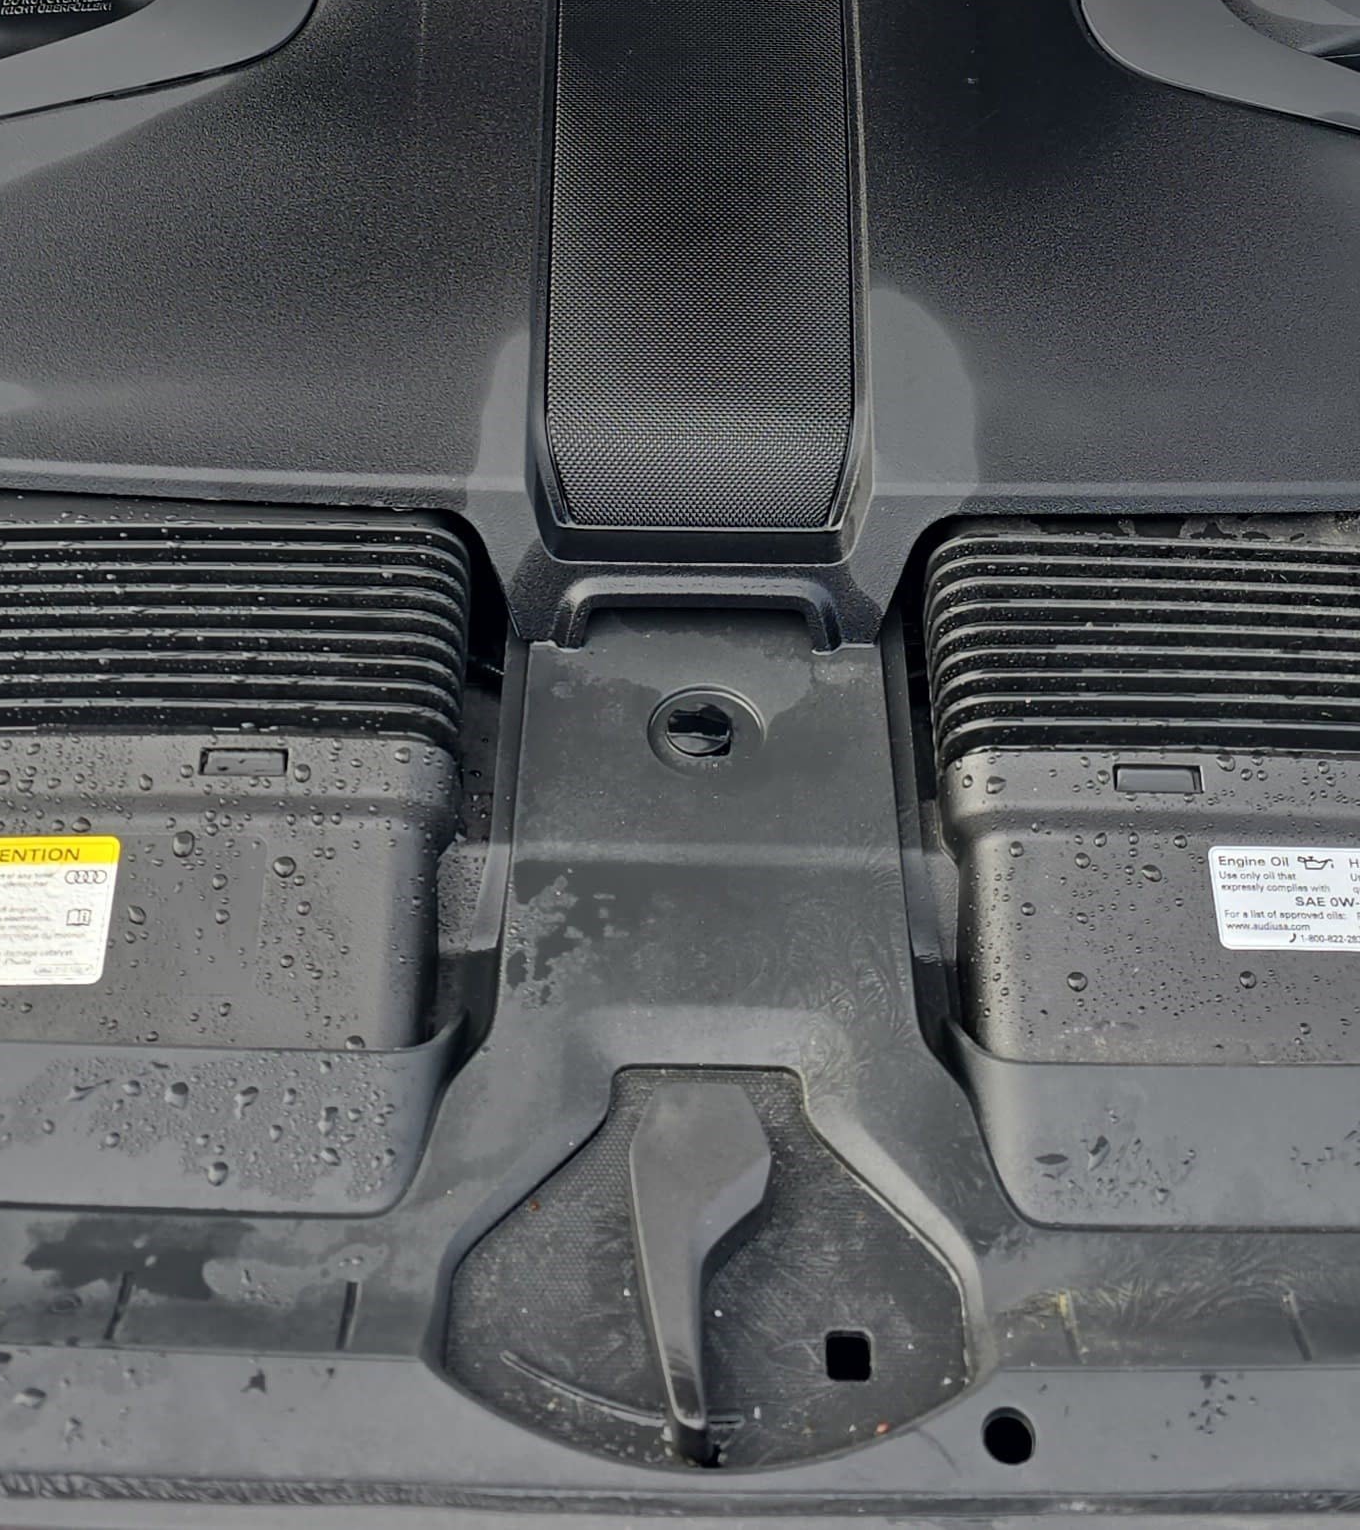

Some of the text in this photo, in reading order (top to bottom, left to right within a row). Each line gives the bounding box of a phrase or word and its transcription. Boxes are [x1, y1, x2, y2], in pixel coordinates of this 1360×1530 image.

[1218, 856, 1290, 868] Engine Oil
[1218, 871, 1297, 882] Use only oil that
[1221, 883, 1331, 894] expressly complies with
[1295, 896, 1326, 907] SAE
[1224, 910, 1240, 918] For
[1250, 910, 1265, 919] list
[1267, 910, 1277, 919] of
[1279, 910, 1325, 921] approved
[1226, 922, 1311, 932] www.audiusa.com
